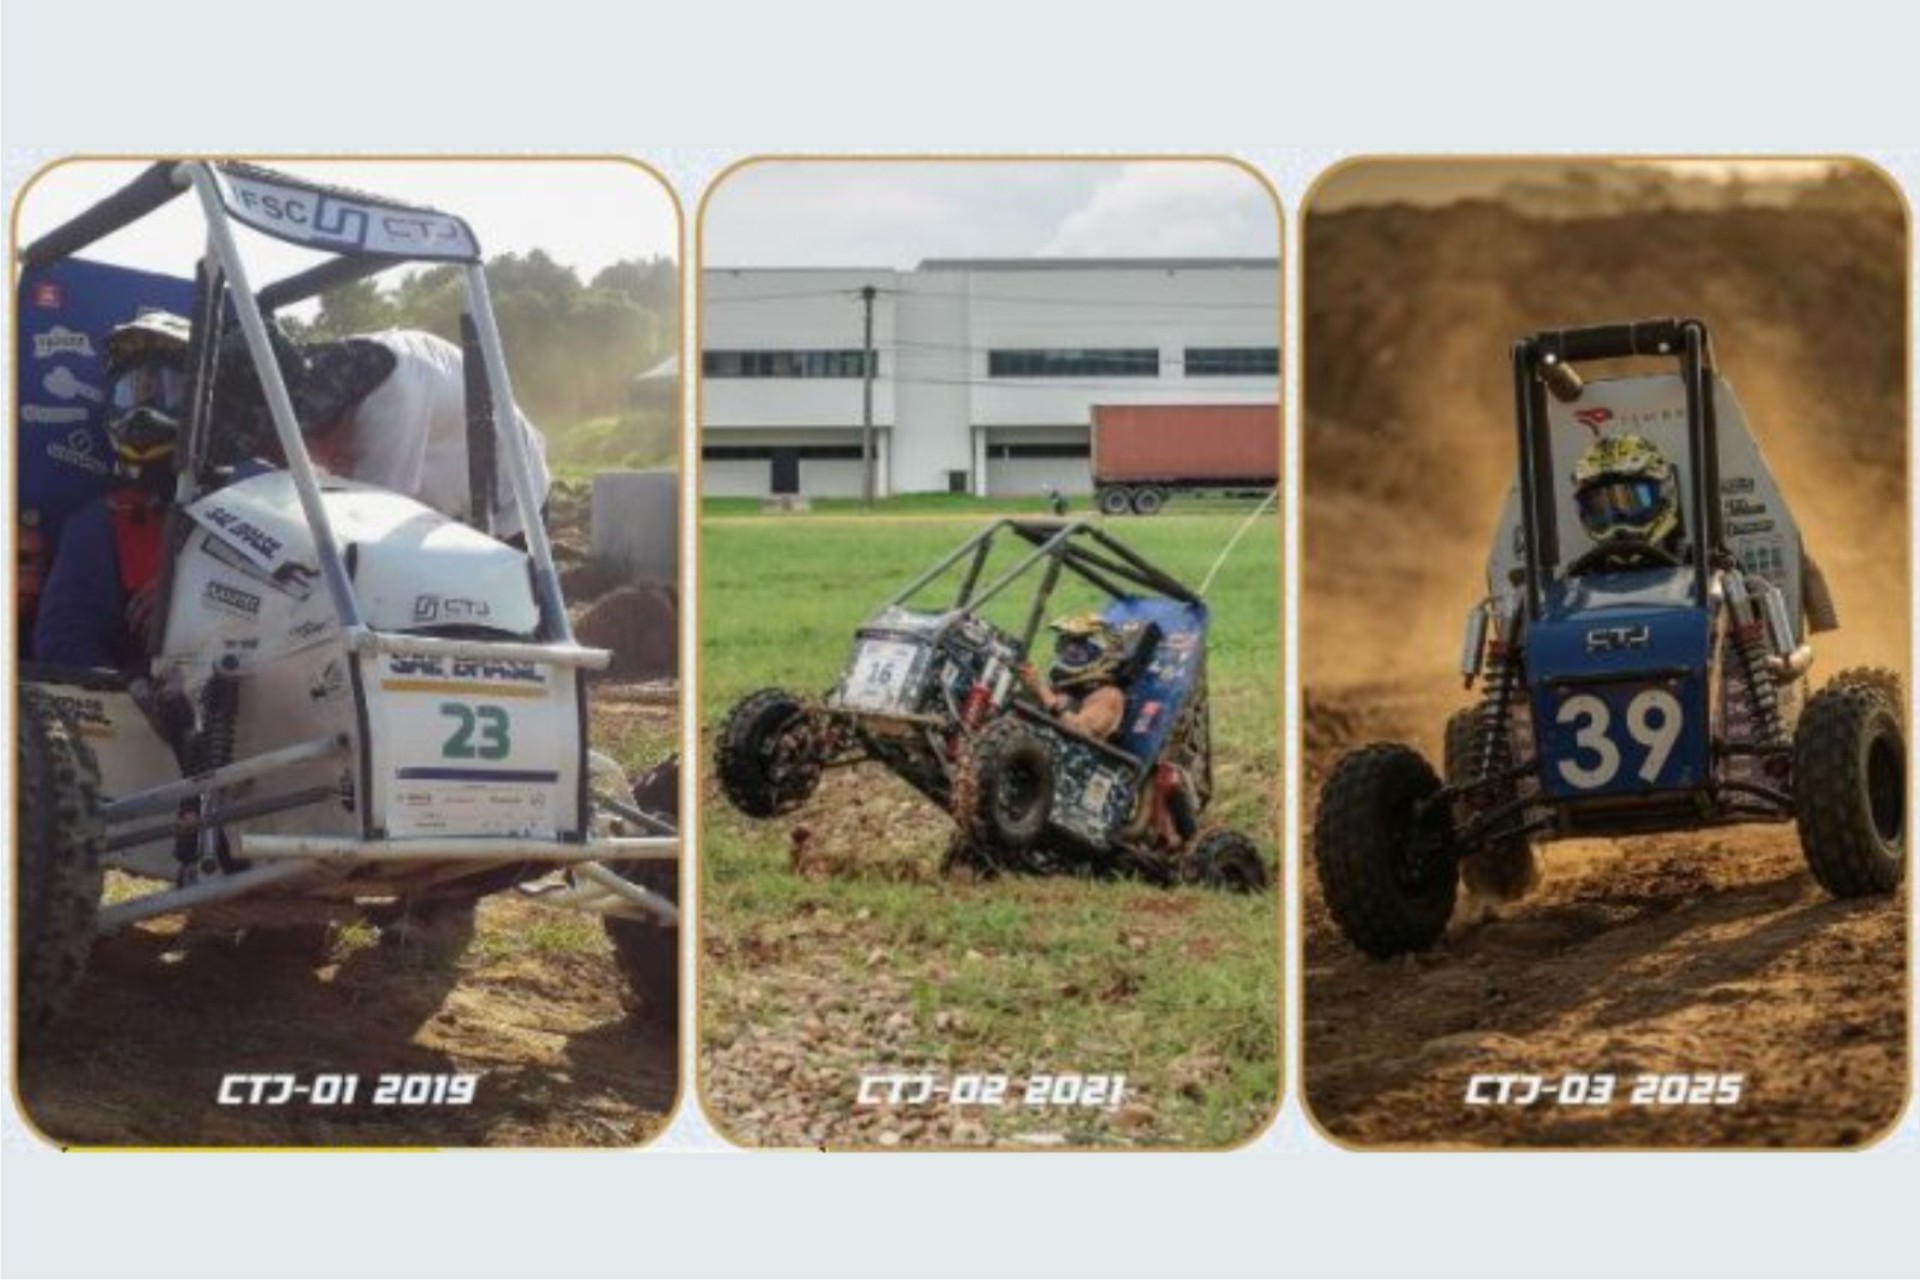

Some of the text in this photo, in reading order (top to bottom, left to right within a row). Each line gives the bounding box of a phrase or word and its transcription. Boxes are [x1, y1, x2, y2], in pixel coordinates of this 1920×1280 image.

[445, 599, 490, 617] CTJ
[1588, 625, 1650, 646] CTJ
[867, 661, 893, 686] 16
[440, 702, 512, 761] 23
[1556, 688, 1684, 789] 39
